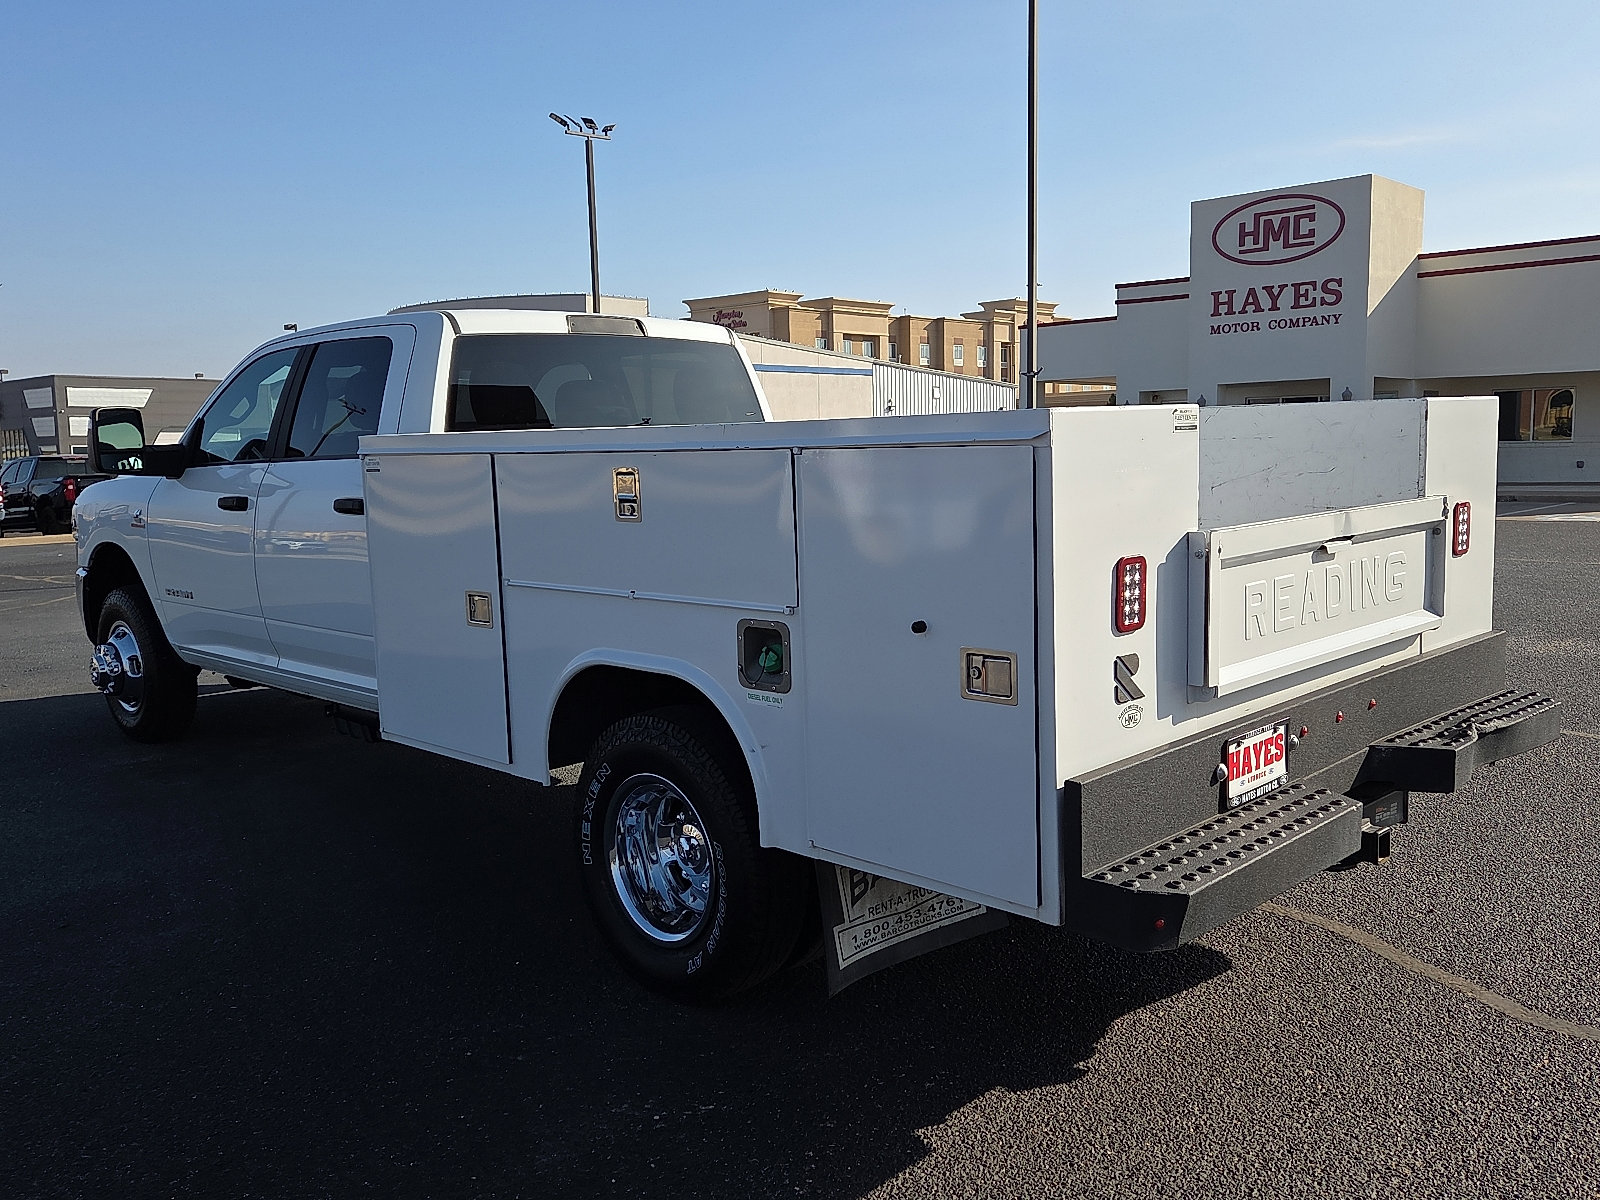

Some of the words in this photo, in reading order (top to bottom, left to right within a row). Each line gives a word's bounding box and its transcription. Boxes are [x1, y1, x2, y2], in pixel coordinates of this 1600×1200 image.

[1238, 204, 1316, 254] HMC
[1210, 277, 1343, 317] HAYES
[1209, 321, 1261, 335] MOTOR
[1268, 313, 1343, 330] COMPANY
[1244, 551, 1407, 641] READING
[761, 695, 772, 703] FUEL
[772, 696, 783, 704] ONLY
[1228, 733, 1284, 781] HAYES
[581, 762, 611, 865] NEXEN
[868, 888, 935, 918] RENT-A-TRU
[853, 904, 965, 950] WWW.BARCOTRUCKS.COM
